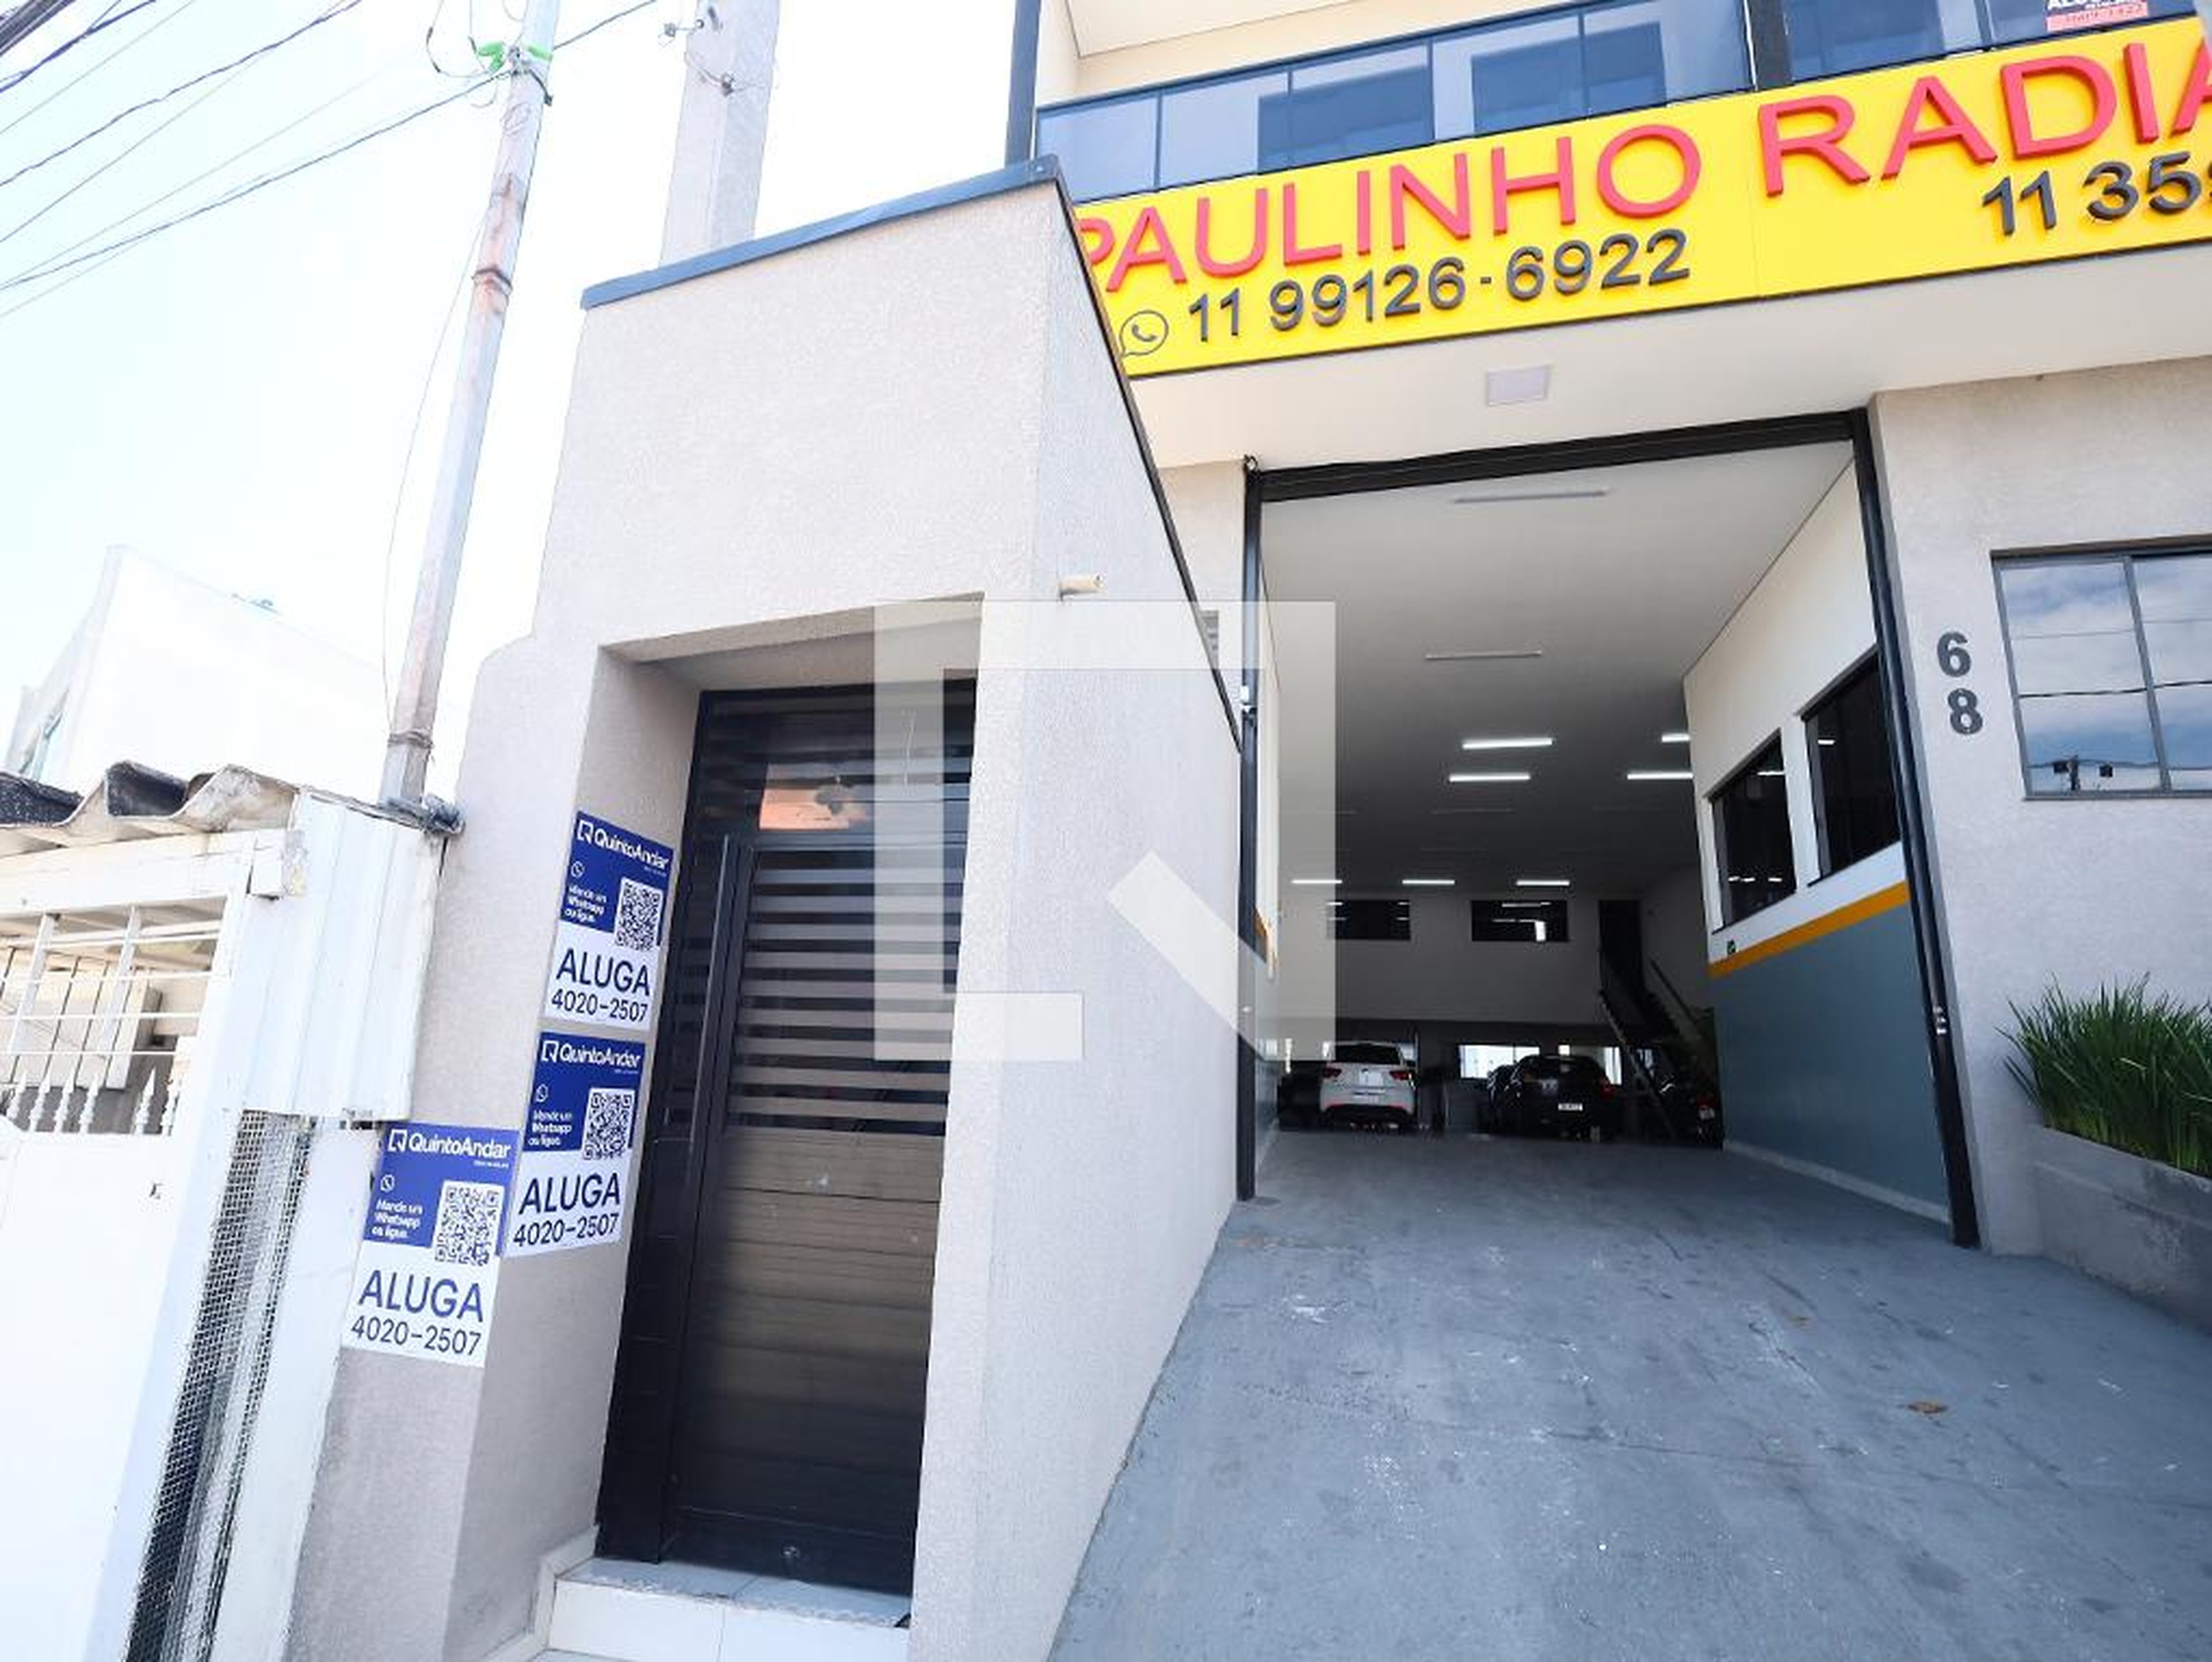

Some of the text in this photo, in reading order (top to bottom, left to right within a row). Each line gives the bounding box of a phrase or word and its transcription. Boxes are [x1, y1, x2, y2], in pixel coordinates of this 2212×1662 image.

[1983, 170, 2056, 237] 11
[1188, 288, 1241, 343] 11
[556, 947, 650, 997] ALUGA
[551, 988, 648, 1022] 4020-2507
[560, 1043, 641, 1068] QuintoAndar
[408, 1133, 512, 1159] QuintoAndar
[518, 1172, 620, 1215] ALUGA
[513, 1213, 619, 1247] 4020-2507
[358, 1269, 483, 1323] ALUGA
[351, 1315, 482, 1356] 4020-2507
